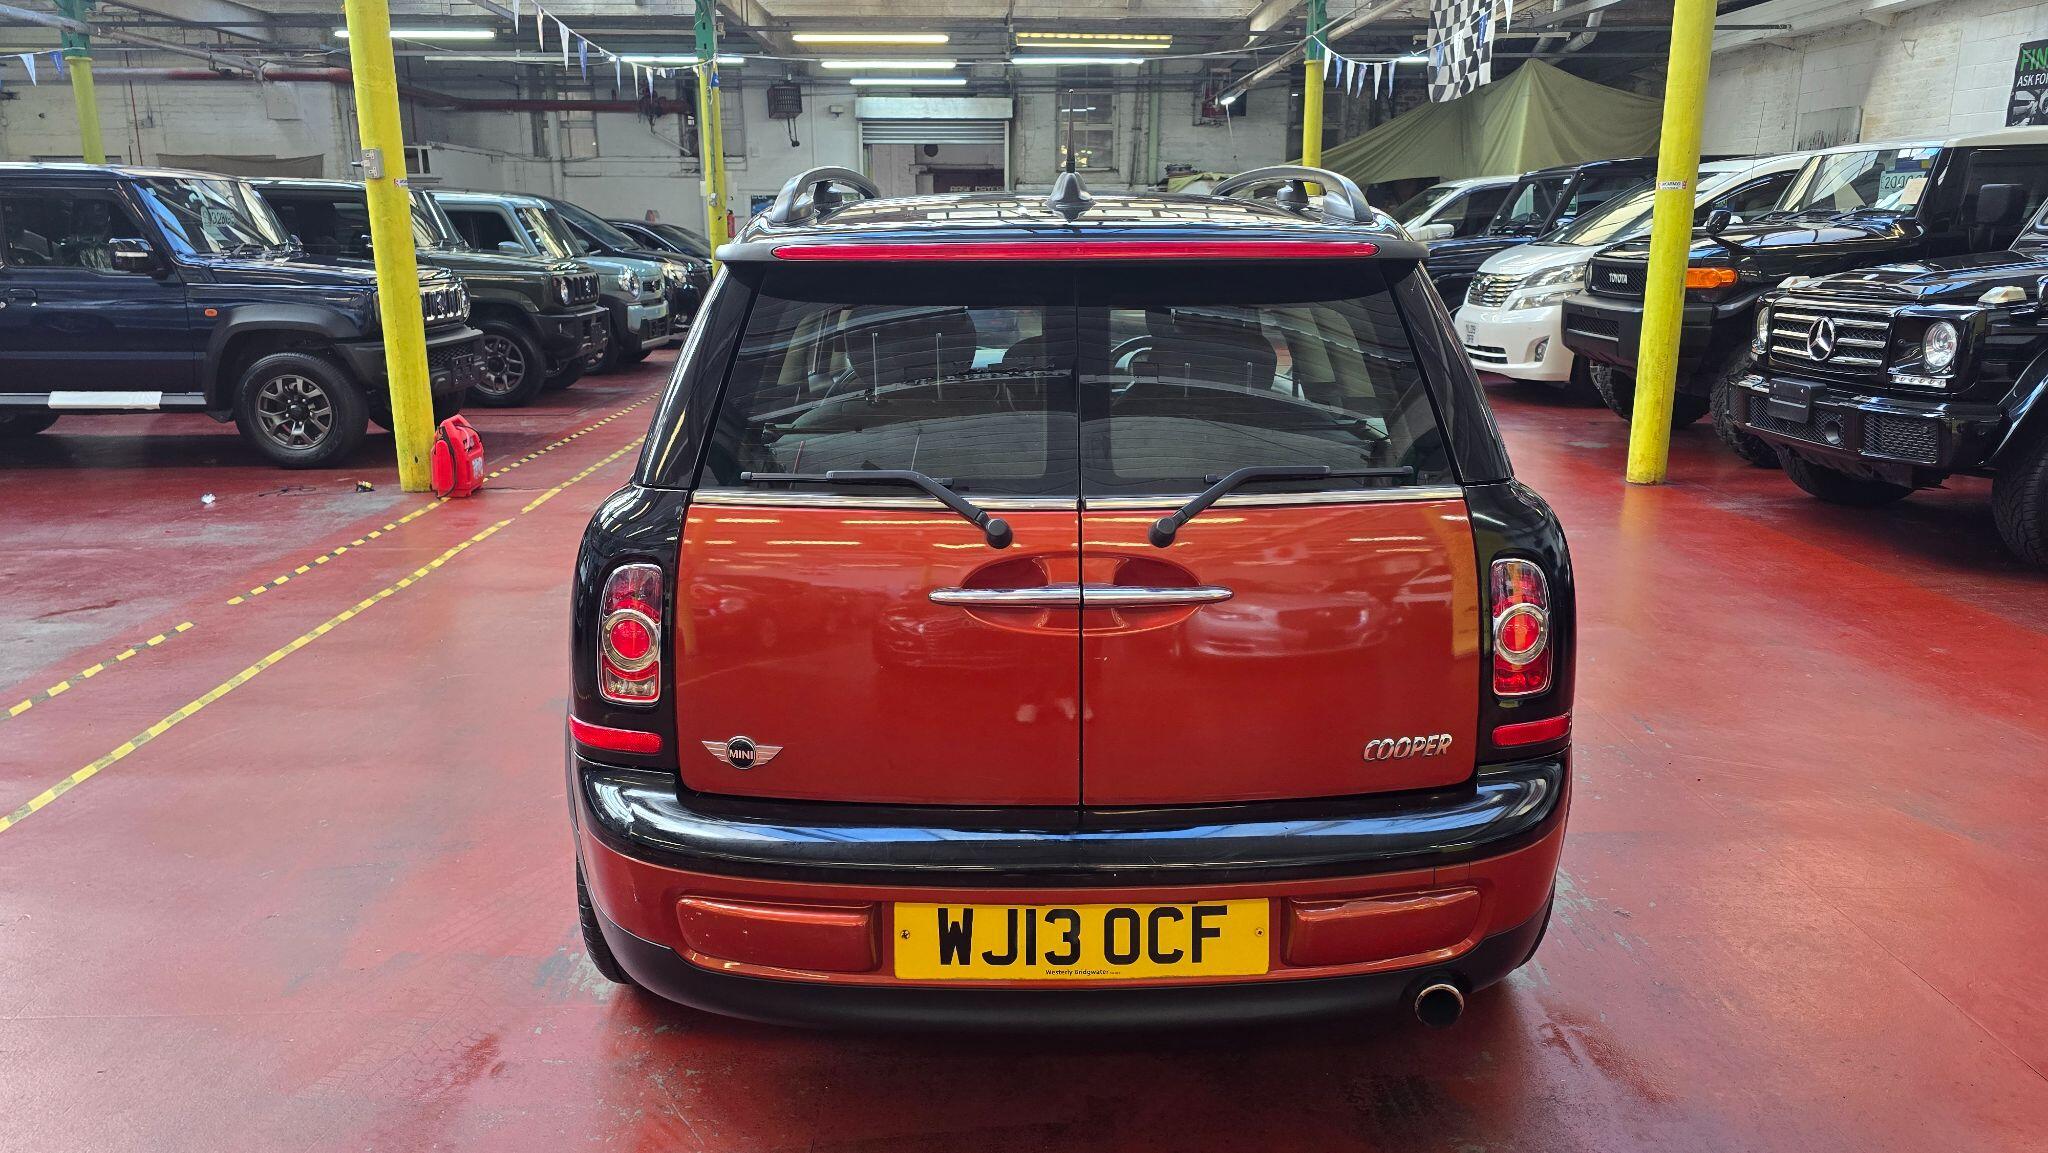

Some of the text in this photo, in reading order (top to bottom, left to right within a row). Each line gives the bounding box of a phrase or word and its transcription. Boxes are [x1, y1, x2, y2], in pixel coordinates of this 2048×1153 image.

[2020, 47, 2048, 71] FIN
[2016, 75, 2034, 87] ASK
[1609, 273, 1628, 284] TOYOTA
[729, 749, 754, 760] MINI
[1363, 733, 1453, 760] COOPER
[938, 905, 1227, 965] WJ13 OCF
